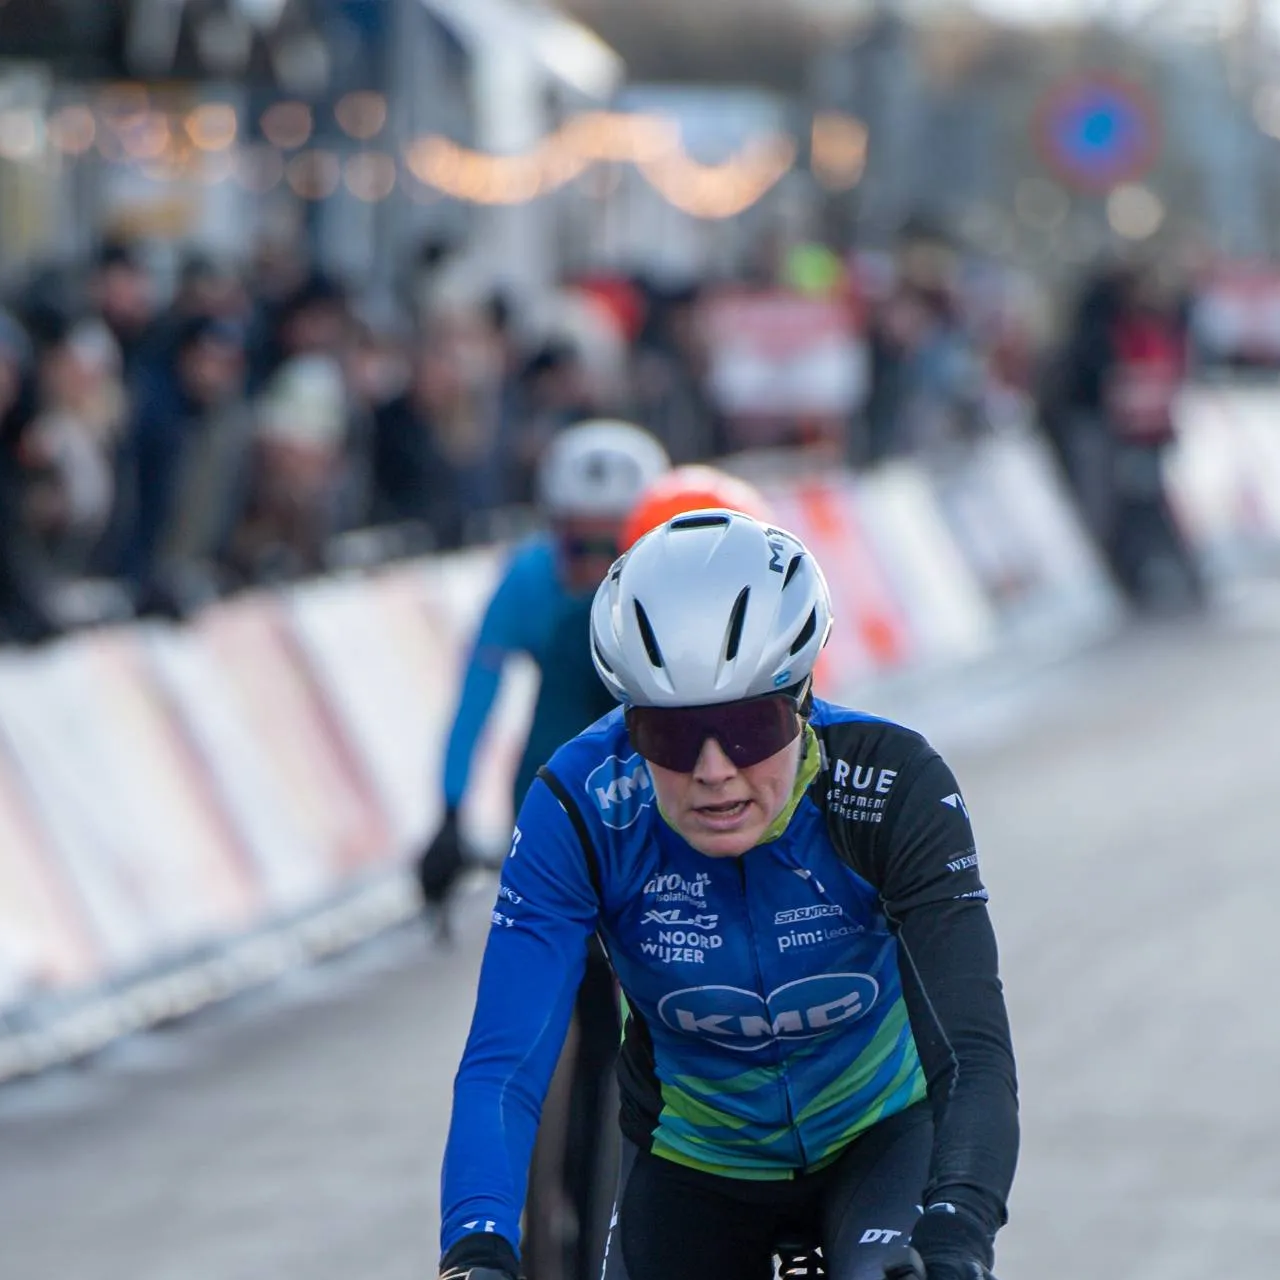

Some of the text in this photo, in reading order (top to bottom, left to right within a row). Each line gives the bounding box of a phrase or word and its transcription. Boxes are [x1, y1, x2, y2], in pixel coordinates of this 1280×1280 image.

[595, 765, 650, 809] KM
[658, 930, 724, 949] NOORD
[640, 942, 705, 964] WIJZER
[675, 991, 862, 1038] KMC
[859, 1229, 902, 1244] DT
